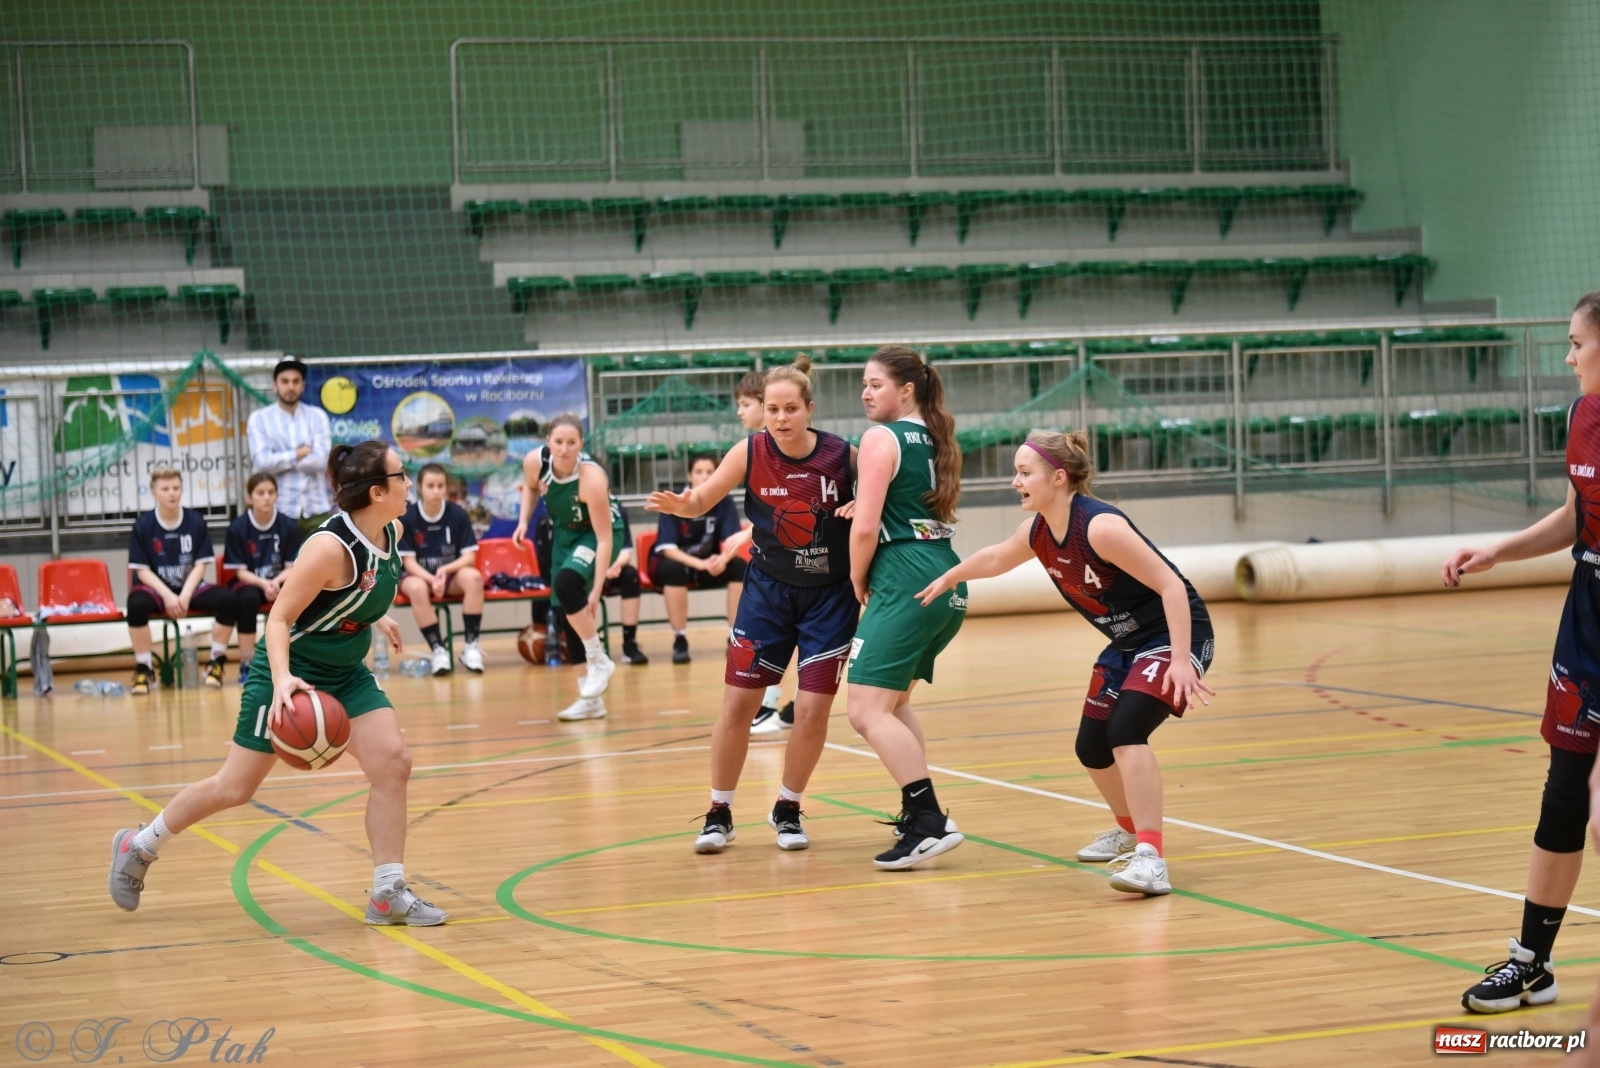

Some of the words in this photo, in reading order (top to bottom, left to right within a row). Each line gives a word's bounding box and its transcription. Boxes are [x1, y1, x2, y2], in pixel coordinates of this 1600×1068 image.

[371, 374, 428, 389] Ośrodek
[431, 373, 474, 387] Sportu
[465, 391, 478, 402] w
[481, 389, 545, 402] Raciborzu
[904, 431, 922, 444] RKK
[820, 475, 839, 503] 14
[571, 505, 583, 522] 3
[180, 534, 193, 554] 10
[445, 526, 451, 544] 1
[1084, 564, 1102, 589] 4
[1141, 661, 1160, 683] 4
